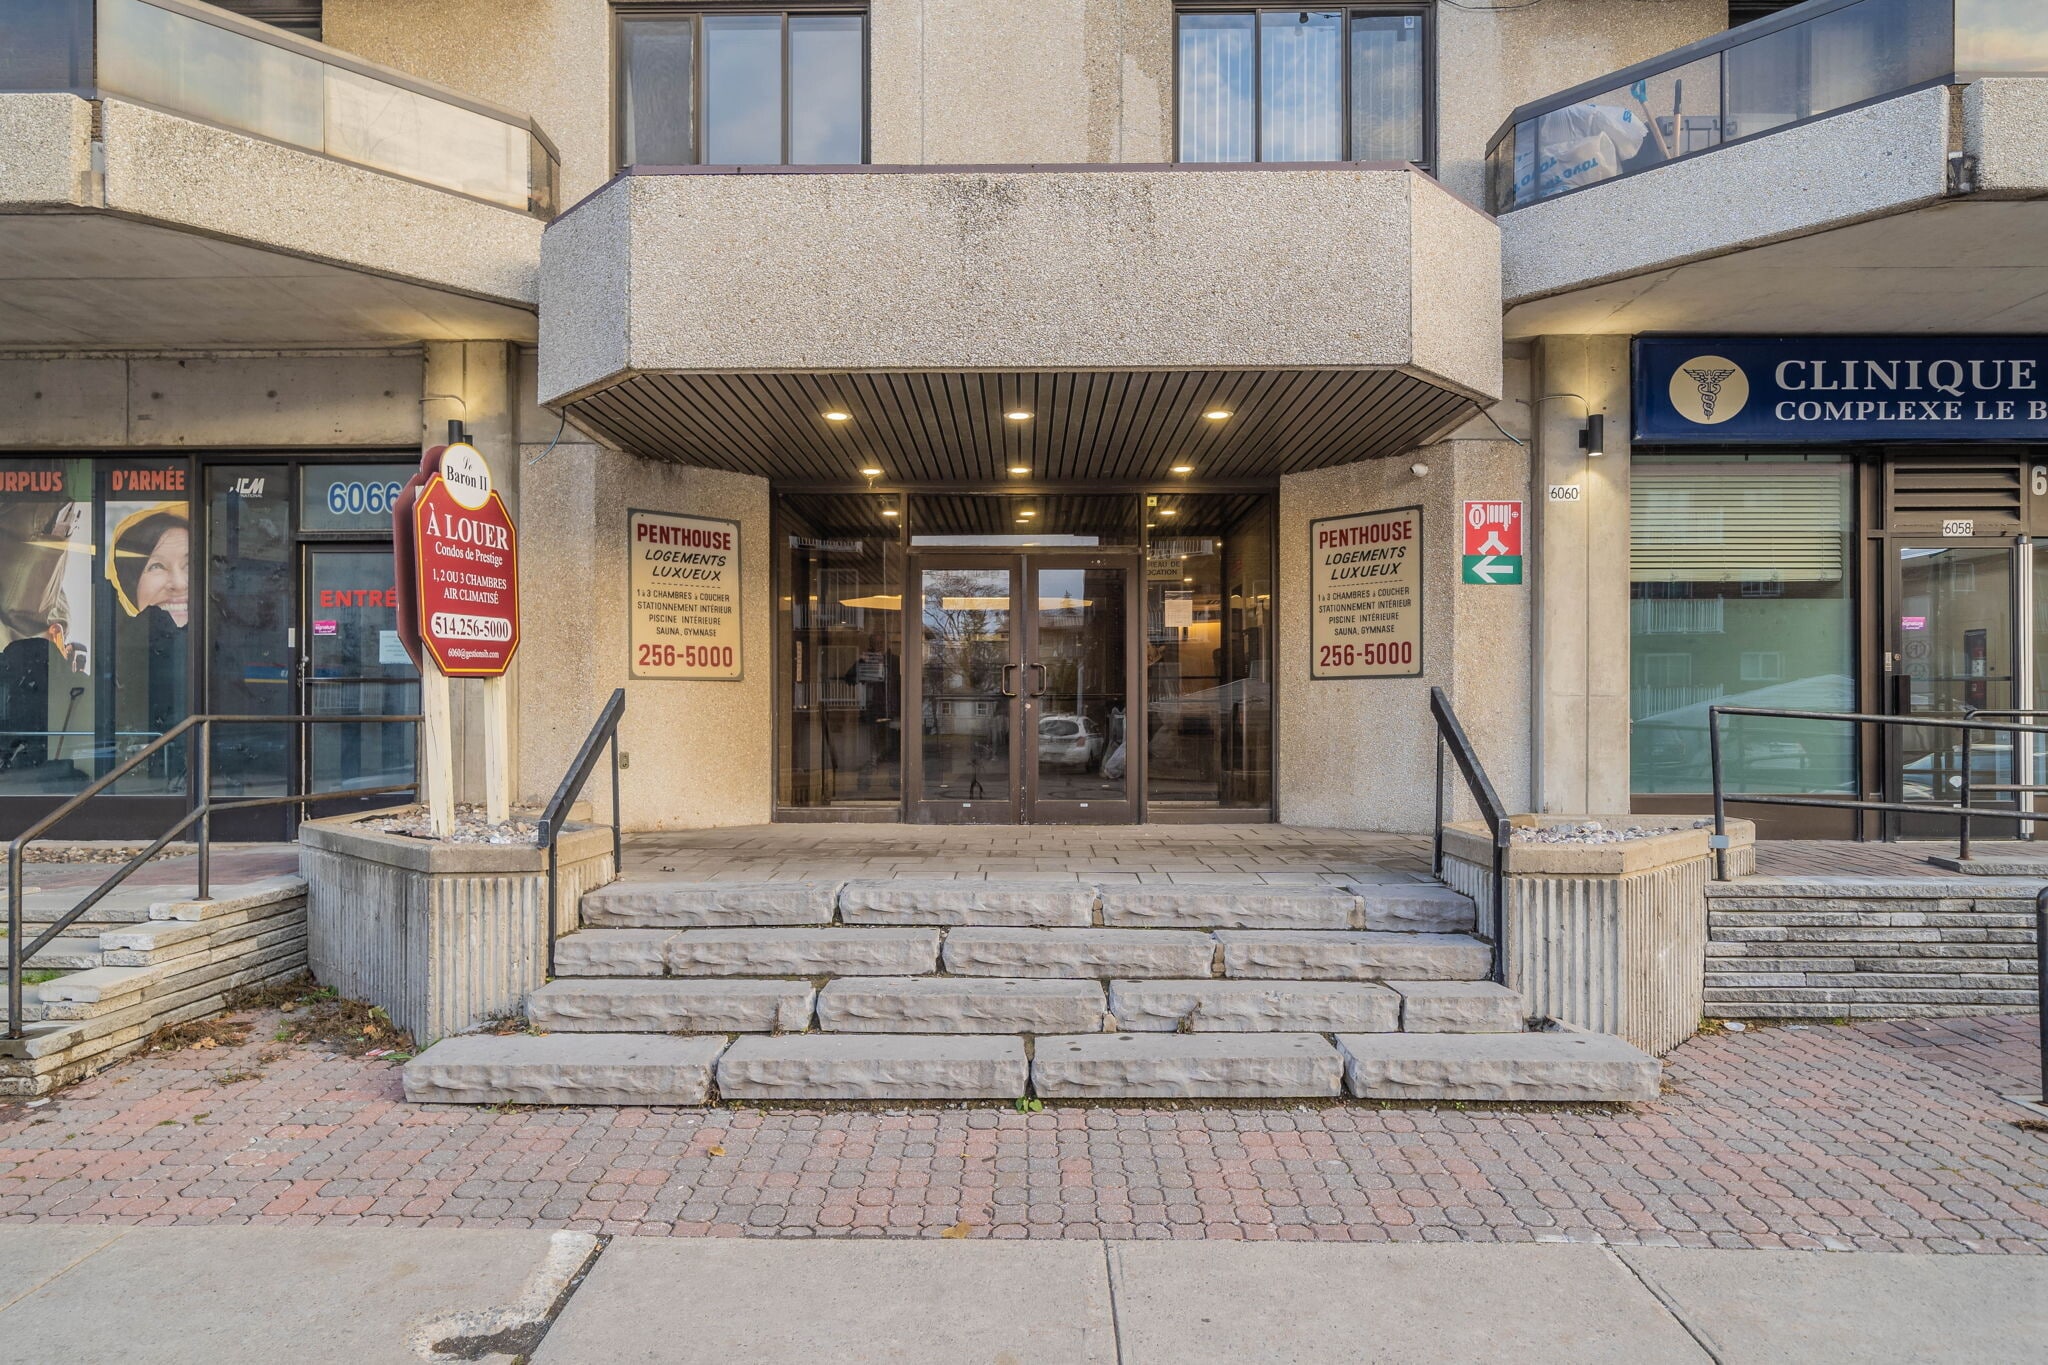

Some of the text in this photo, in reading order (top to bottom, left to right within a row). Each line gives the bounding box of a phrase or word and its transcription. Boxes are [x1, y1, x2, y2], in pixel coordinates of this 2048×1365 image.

[1775, 359, 2037, 397] CLINIQUE
[1775, 400, 2048, 421] COMPLEXE LE B
[112, 466, 185, 491] D'ARMÉE
[447, 465, 488, 492] Baron II
[2031, 465, 2048, 496] 6
[328, 482, 402, 514] 6066
[1551, 487, 1578, 500] 6060
[426, 502, 509, 551] À LOUER
[1320, 520, 1412, 549] PENTHOUSE
[1944, 522, 1972, 535] 6058
[637, 523, 731, 551] PENTHOUSE
[435, 541, 503, 567] Condos de Prestige
[645, 549, 727, 567] LOGEMENTS
[1325, 546, 1406, 566] LOGEMENTS
[432, 568, 507, 590] 1, 2 OU 3 CHAMBRES
[652, 565, 721, 581] LUXUEUX
[1330, 562, 1402, 580] LUXUEUX
[443, 587, 499, 604] AIR CLIMATISÉ
[646, 589, 651, 597] 3
[653, 590, 692, 600] CHAMBRES
[700, 593, 730, 602] COUCHER
[1327, 593, 1331, 601] 3
[1332, 590, 1370, 601] CHAMBRES
[1378, 586, 1410, 597] COUCHER
[637, 601, 732, 614] STATIONNEMENT INTÉRIEUR
[1319, 598, 1411, 613] STATIONNEMENT INTÉRIEUR
[435, 616, 508, 639] 514.256-5000
[649, 614, 721, 626] PISCINE INTÉRIEURE
[1328, 612, 1399, 625] PISCINE INTÉRIEURE
[684, 627, 716, 637] GYMNASE
[1361, 624, 1395, 635] GYMNASE
[638, 644, 733, 668] 256-5000
[1320, 641, 1412, 667] 256-5000
